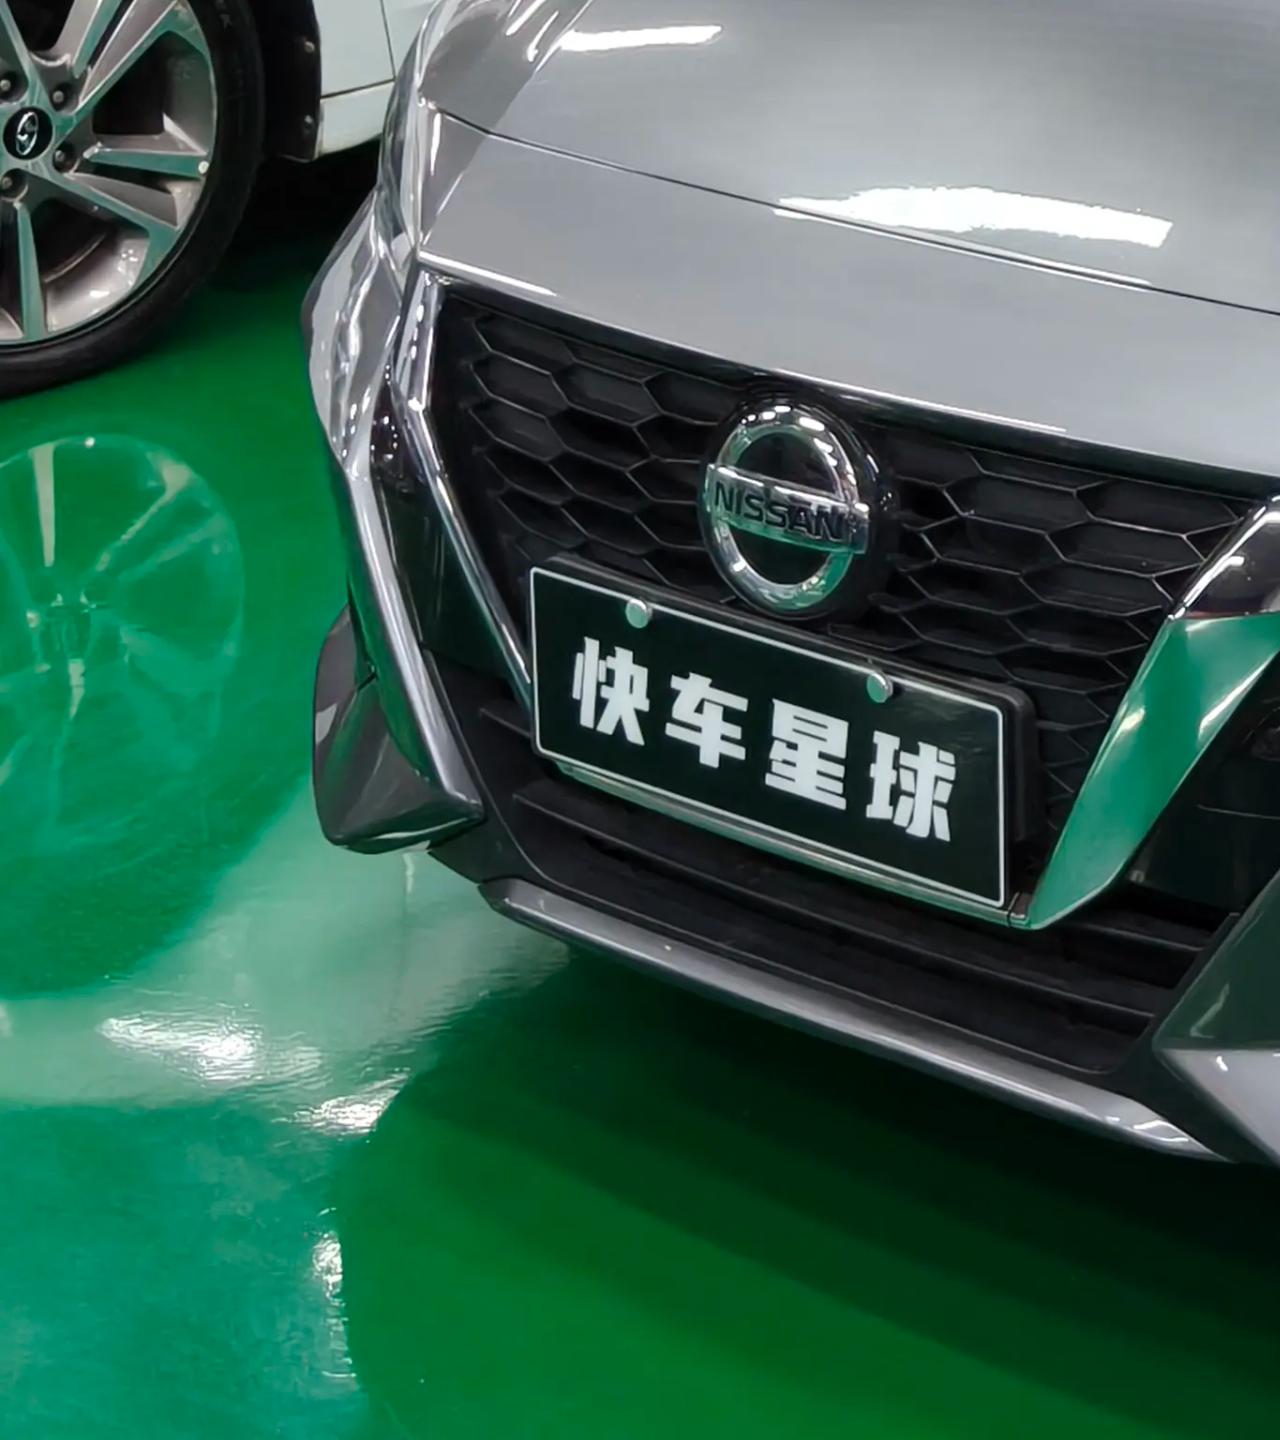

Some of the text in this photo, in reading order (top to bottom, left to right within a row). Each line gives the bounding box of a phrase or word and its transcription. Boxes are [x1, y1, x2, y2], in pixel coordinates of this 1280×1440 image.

[713, 481, 848, 543] NISSAN
[571, 636, 957, 843] 快车星球
